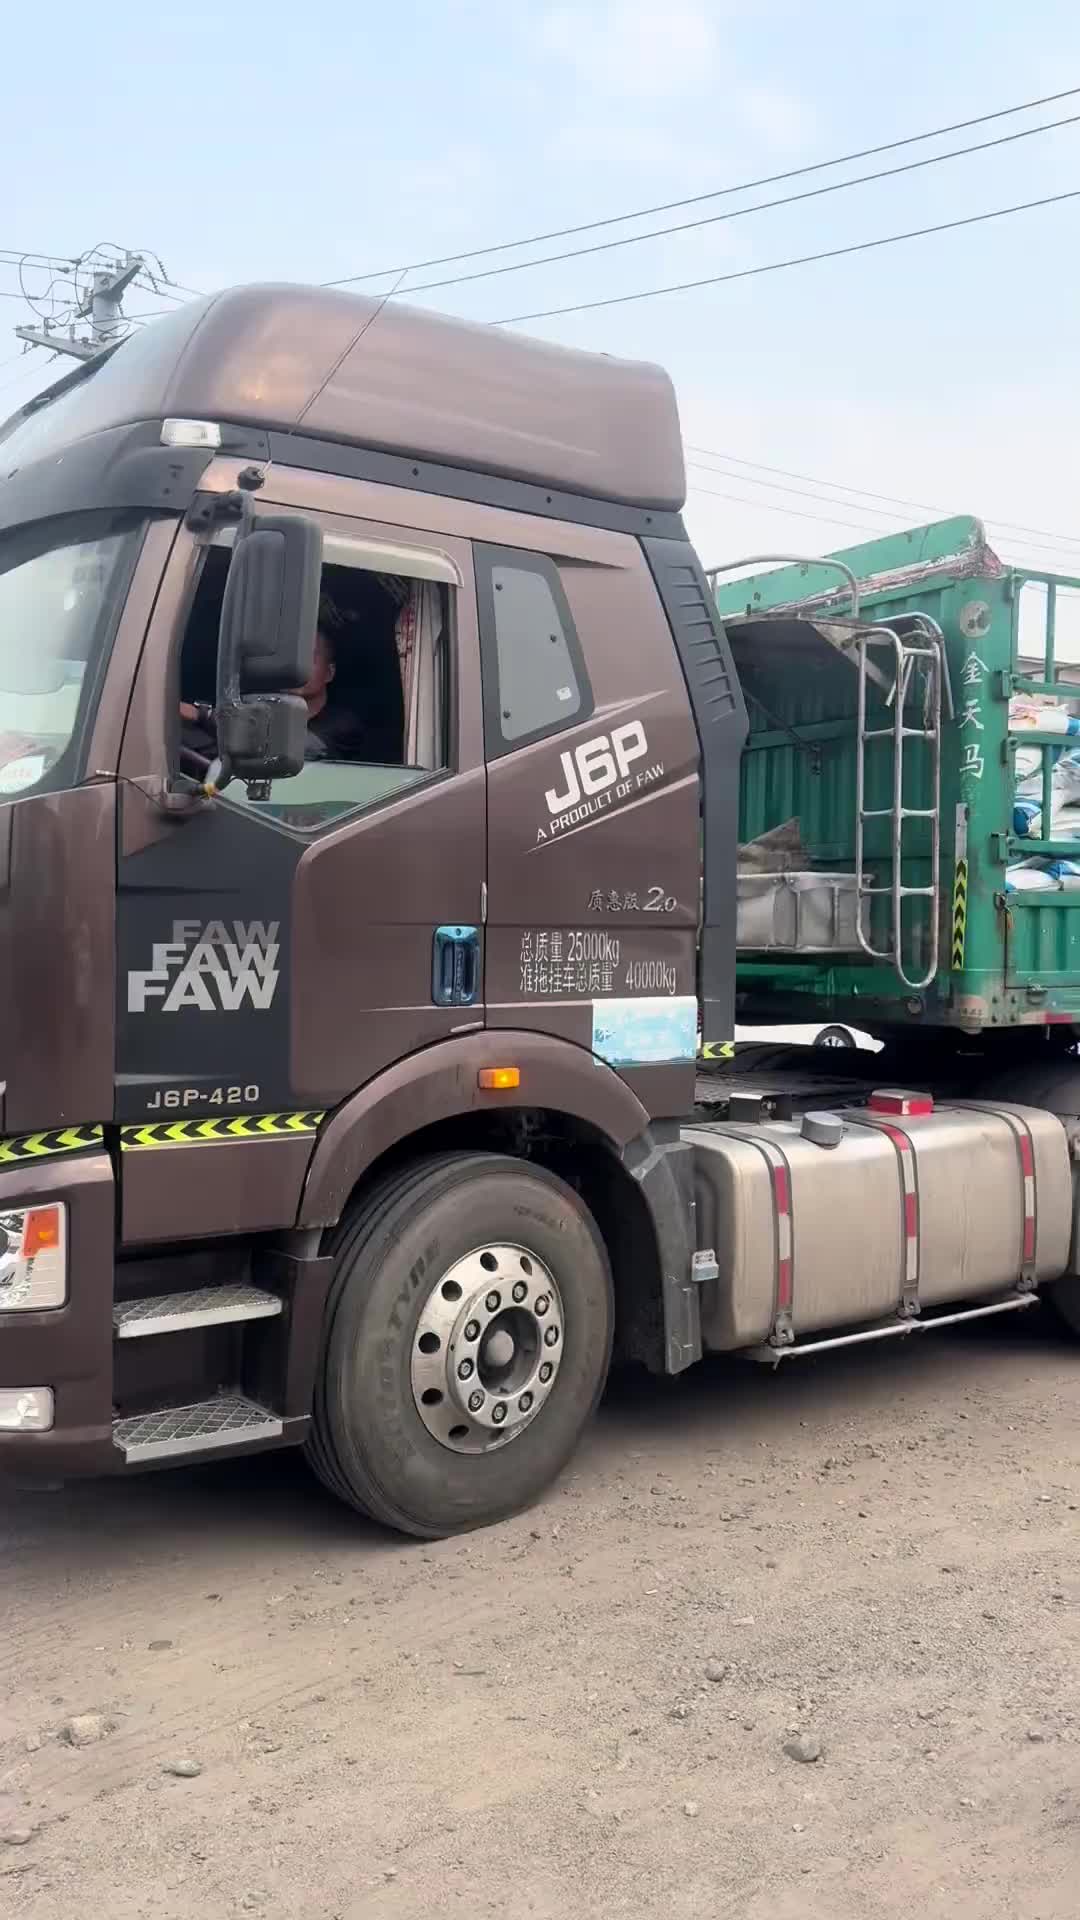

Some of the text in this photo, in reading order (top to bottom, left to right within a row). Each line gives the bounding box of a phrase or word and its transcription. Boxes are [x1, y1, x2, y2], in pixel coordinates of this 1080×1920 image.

[958, 652, 989, 778] 金天马
[545, 720, 648, 814] J6P
[536, 762, 665, 842] A PRODUCT OF FAW
[642, 886, 678, 912] 2.0
[172, 920, 280, 949] FAW
[520, 931, 620, 968] 总质量 25000kg
[152, 943, 280, 977] FAW
[520, 960, 676, 996] 准拖挂车总质量 40000kg
[128, 970, 280, 1012] FAW
[147, 1085, 260, 1109] J6P-420
